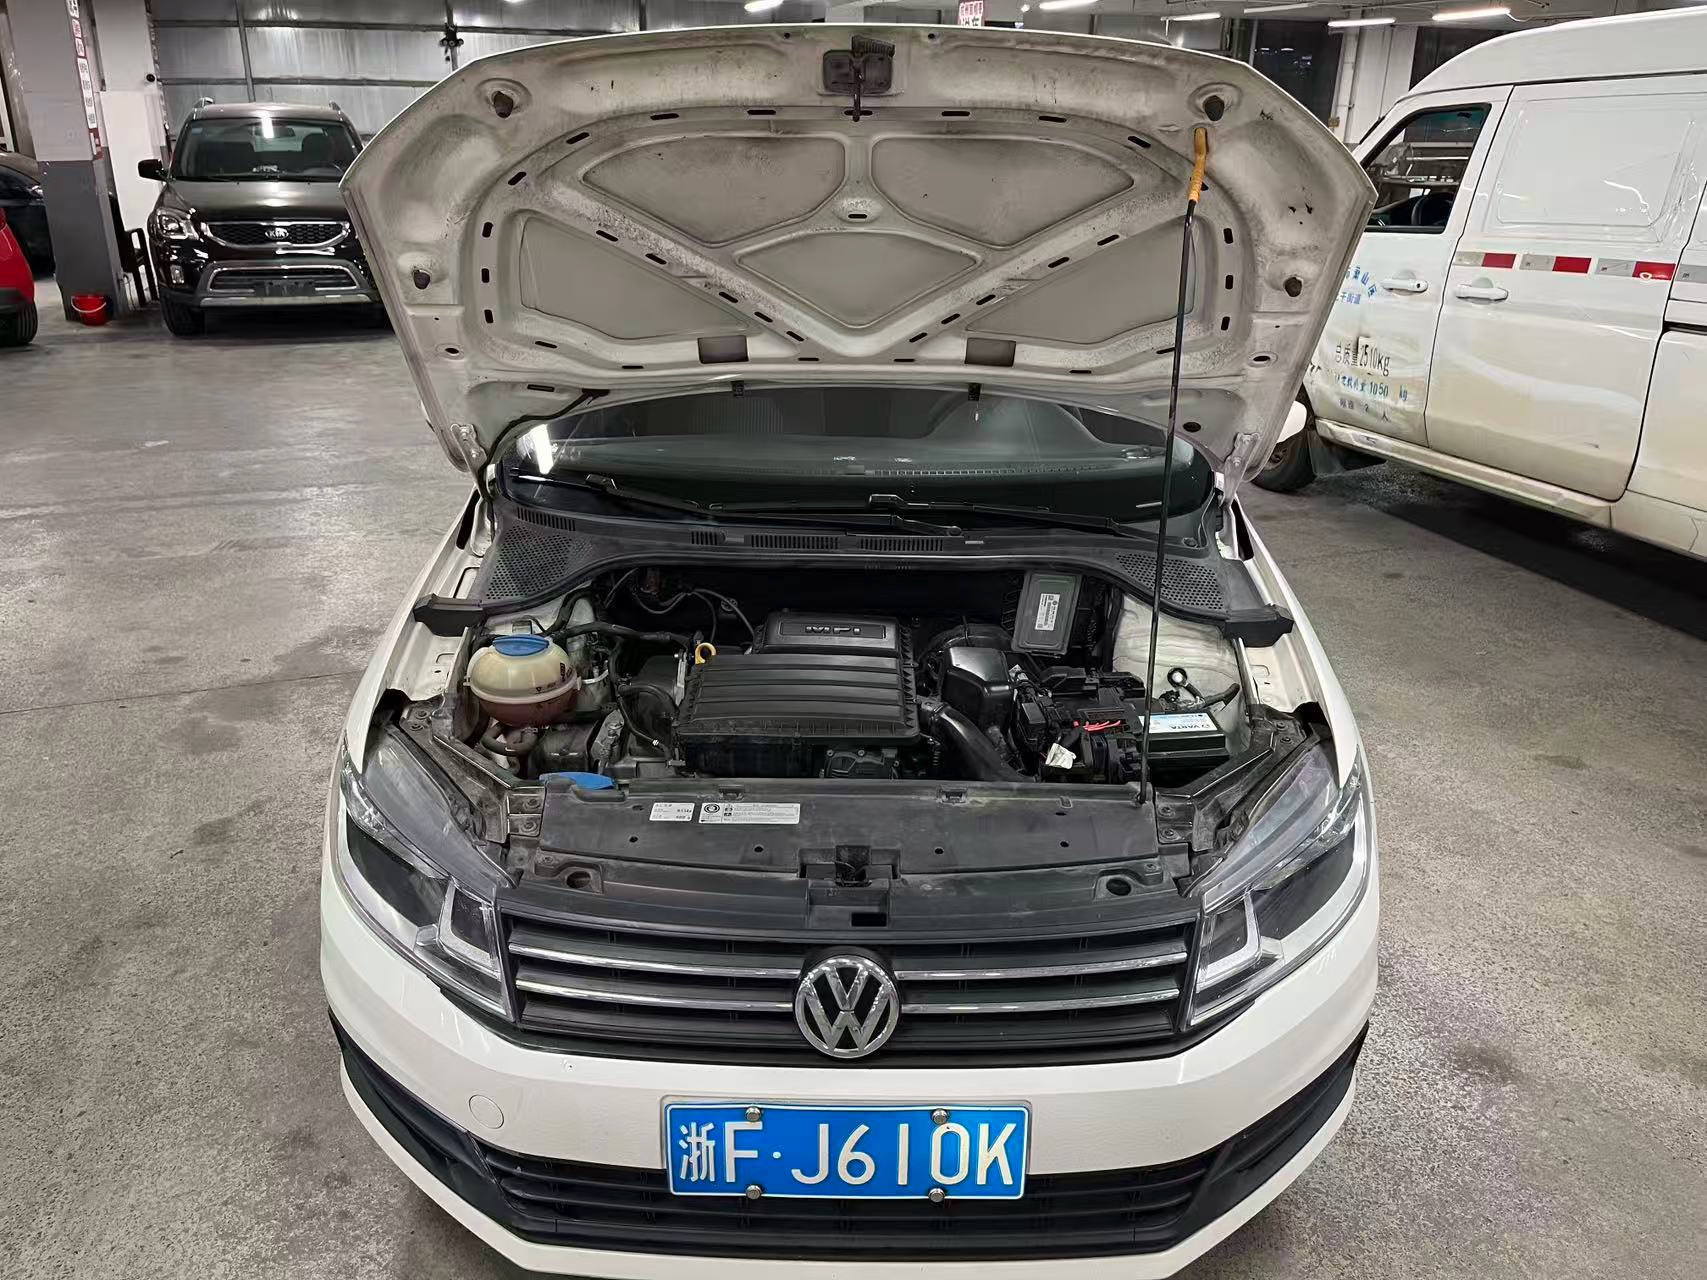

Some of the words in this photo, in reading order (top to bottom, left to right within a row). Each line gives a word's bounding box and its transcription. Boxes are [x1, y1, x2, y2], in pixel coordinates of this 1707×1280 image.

[268, 230, 287, 238] KIA
[1369, 381, 1389, 398] 1050
[805, 625, 861, 634] MPI
